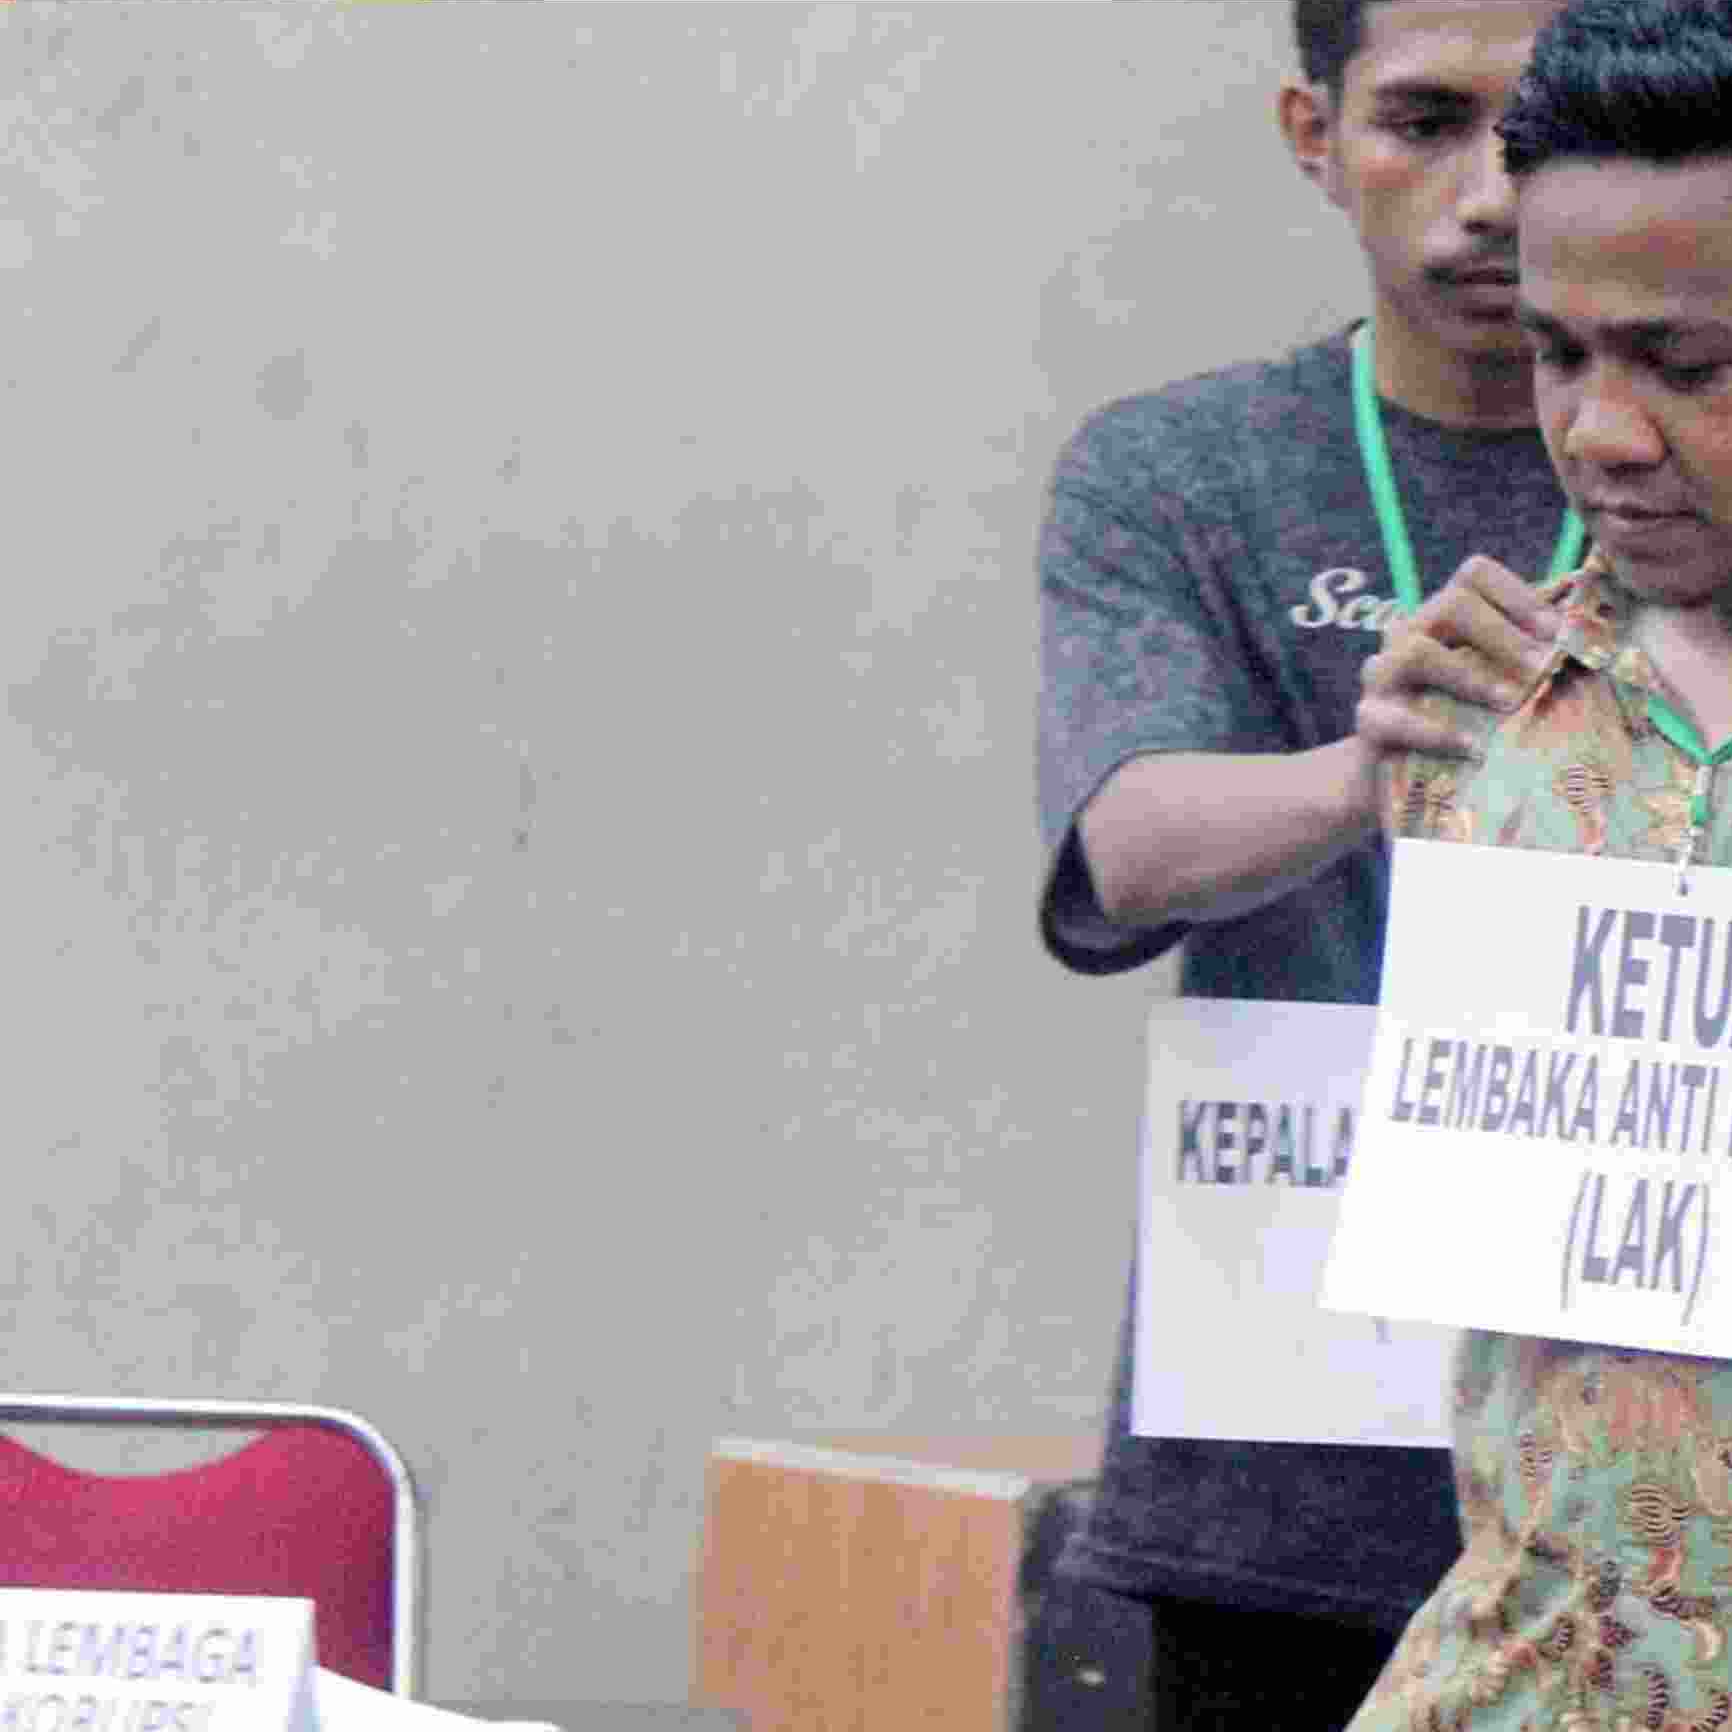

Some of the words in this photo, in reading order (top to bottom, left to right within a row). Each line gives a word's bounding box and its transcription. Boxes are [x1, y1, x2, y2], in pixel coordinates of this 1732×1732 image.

[1390, 1036, 1600, 1145] LEMBAKA
[1609, 1058, 1720, 1157] ANTI
[1559, 1169, 1711, 1327] (LAK)
[23, 1619, 261, 1687] LEMBAGA
